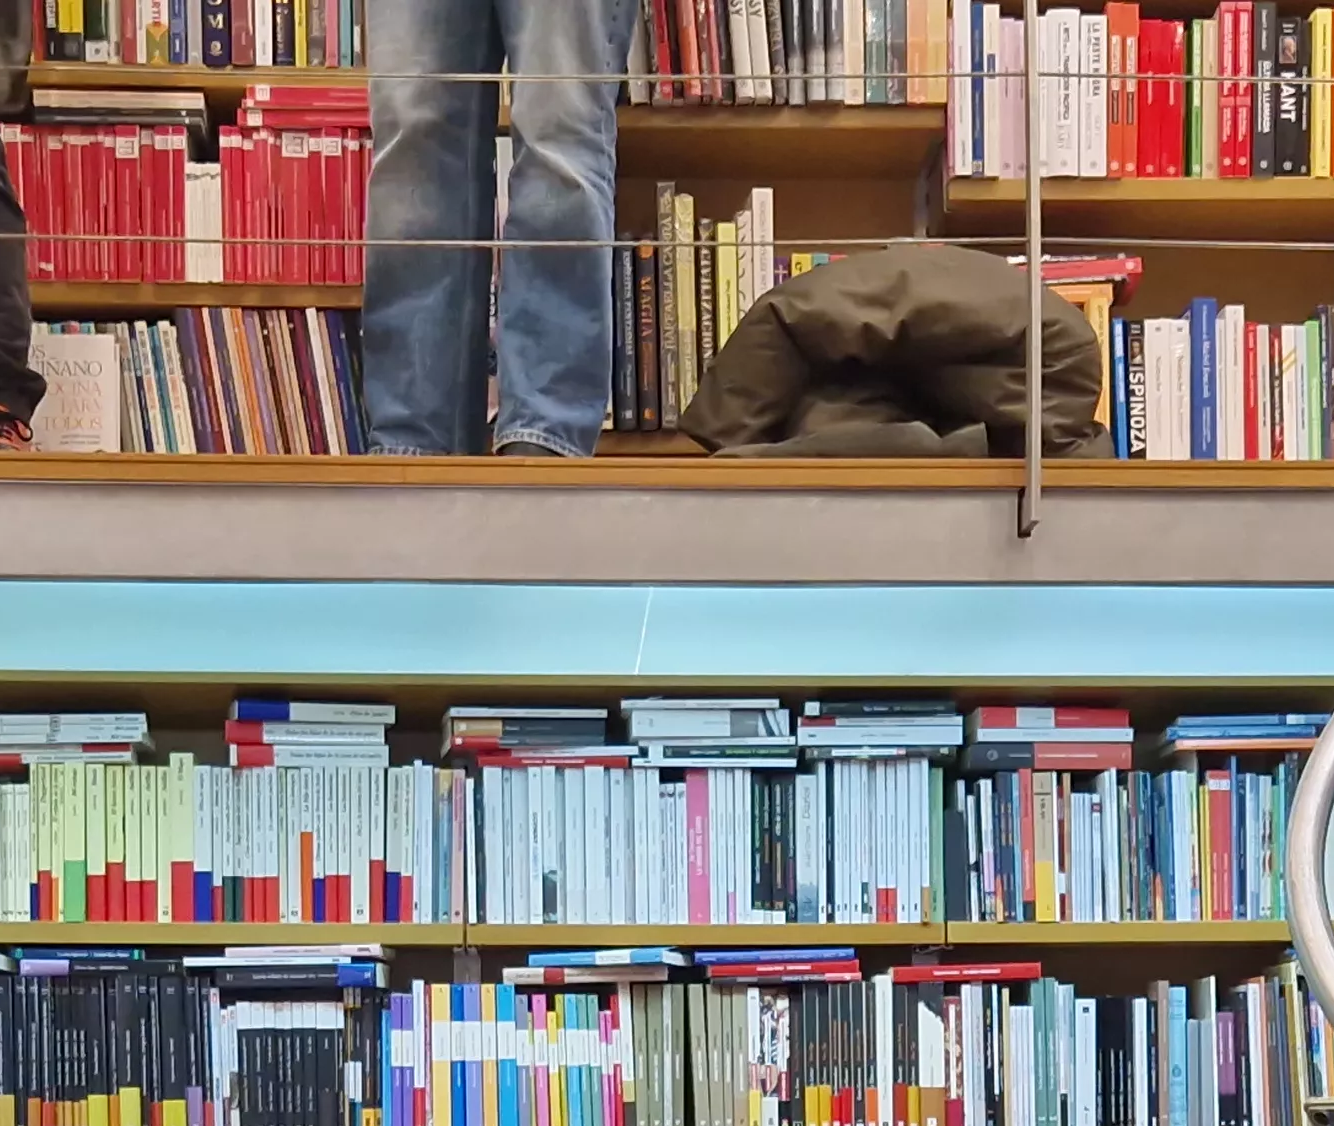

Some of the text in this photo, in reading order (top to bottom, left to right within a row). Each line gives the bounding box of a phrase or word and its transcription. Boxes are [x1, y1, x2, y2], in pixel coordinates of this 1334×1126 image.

[1091, 67, 1101, 97] NGRA
[1280, 71, 1297, 123] KANT
[640, 275, 654, 337] MAGIA
[42, 415, 103, 432] TODOS
[1128, 370, 1146, 454] SPINOZA
